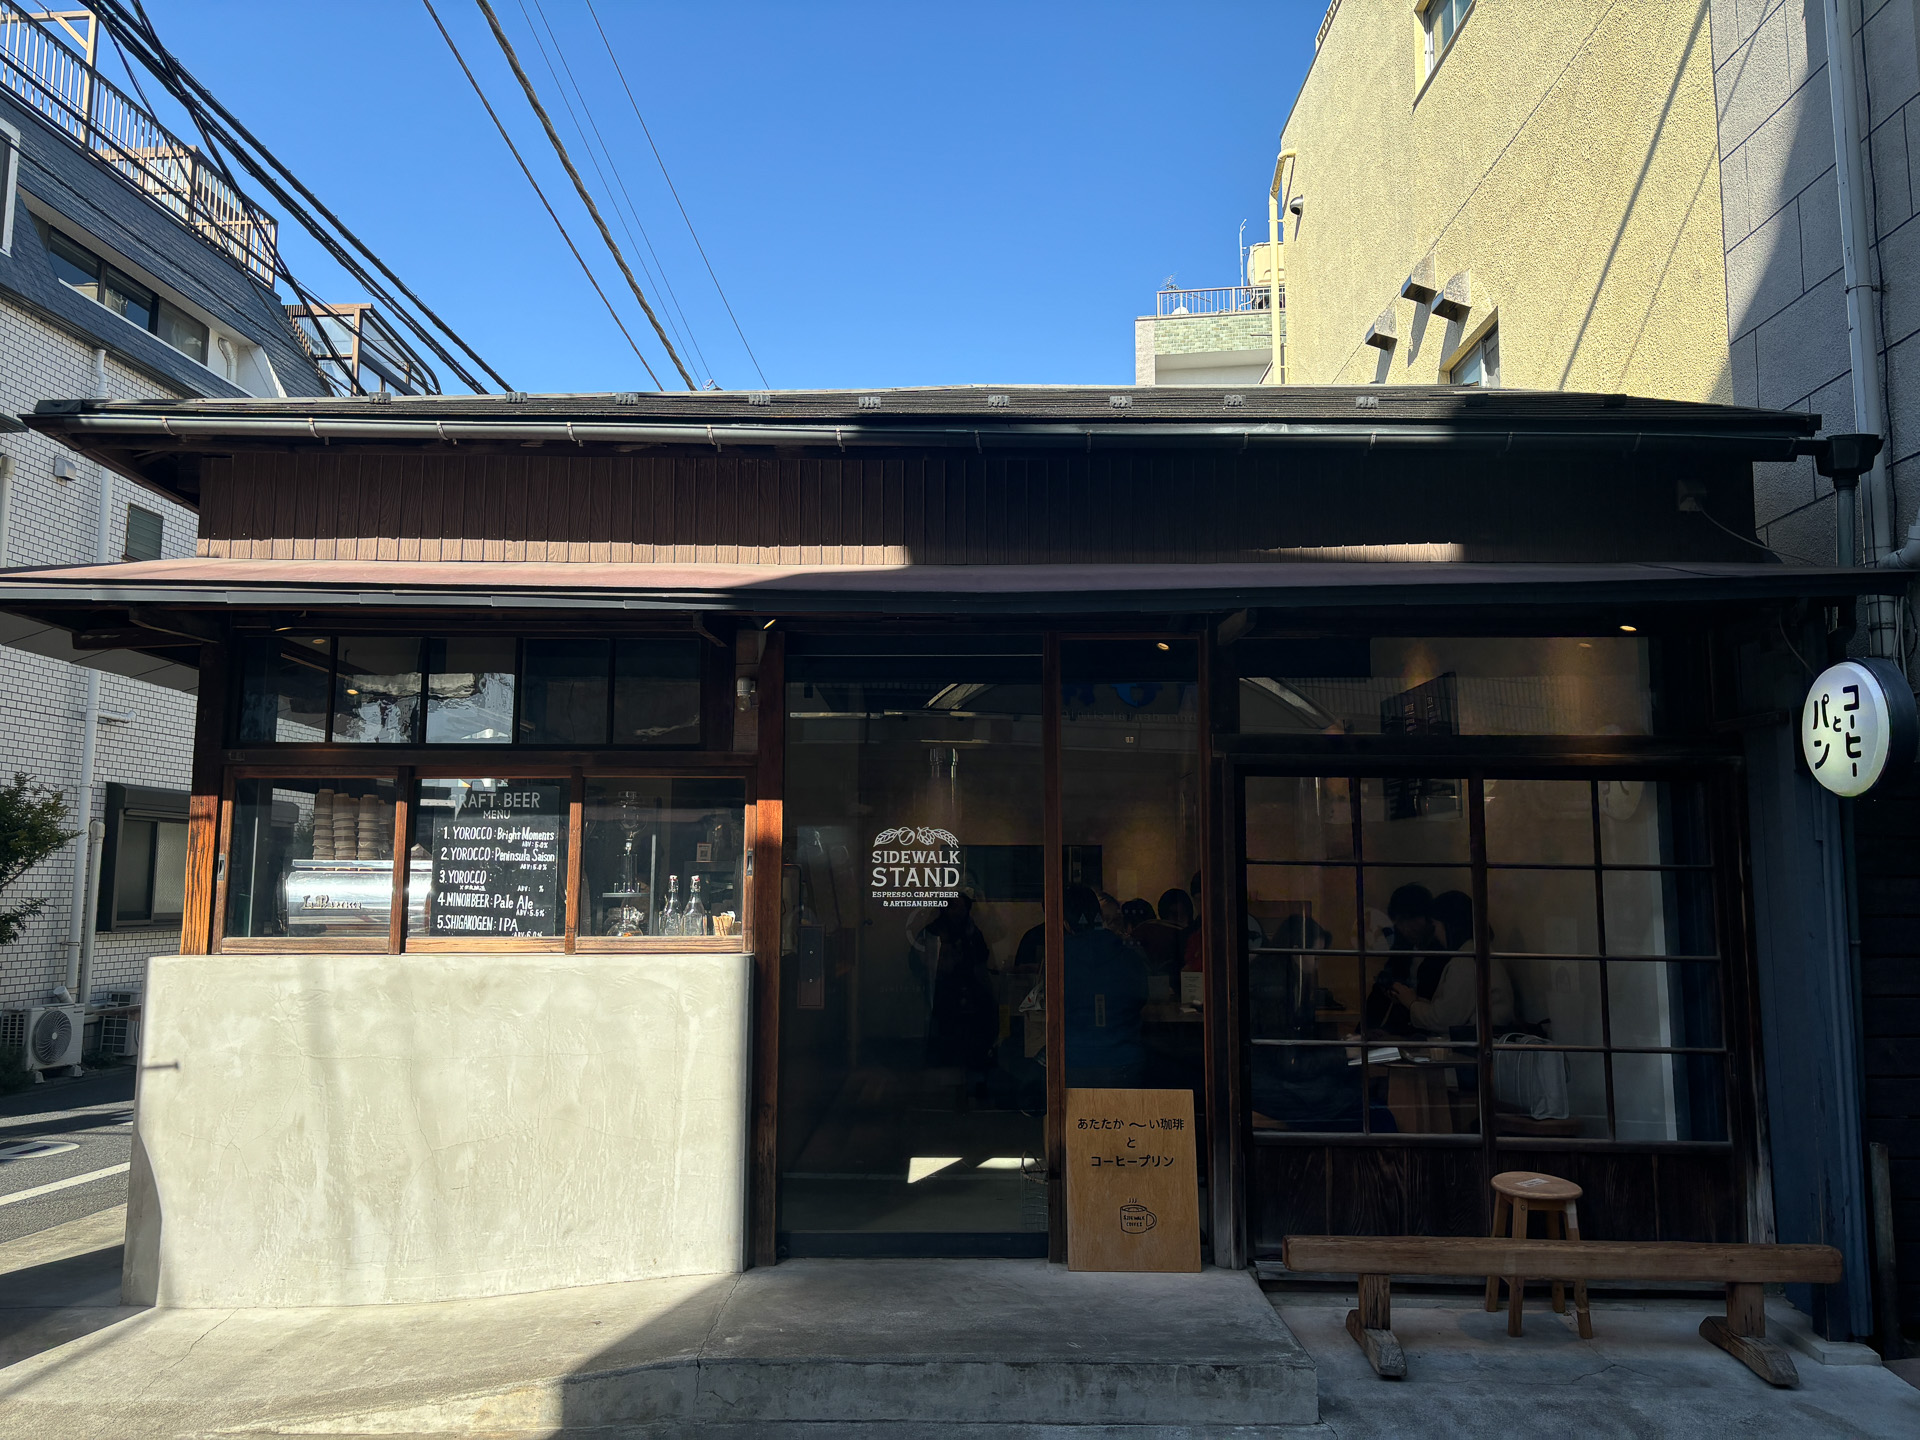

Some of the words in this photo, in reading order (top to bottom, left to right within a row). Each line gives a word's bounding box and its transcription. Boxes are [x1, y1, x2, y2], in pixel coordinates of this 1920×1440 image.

[1812, 693, 1830, 770] パン
[1832, 715, 1842, 733] と
[1842, 684, 1862, 778] コーヒー
[448, 793, 497, 808] CRAFT
[503, 792, 541, 808] BEER
[482, 809, 511, 820] MENU
[521, 826, 555, 841] Moments
[494, 848, 530, 862] Peninsula
[531, 848, 555, 862] Saison
[871, 850, 961, 864] SIDEWALK
[870, 866, 960, 888] STAND
[493, 893, 514, 909] Pale
[516, 894, 534, 910] Ale
[498, 917, 519, 932] IPA
[1126, 1137, 1136, 1148] と
[1091, 1154, 1175, 1168] コーヒープリン
